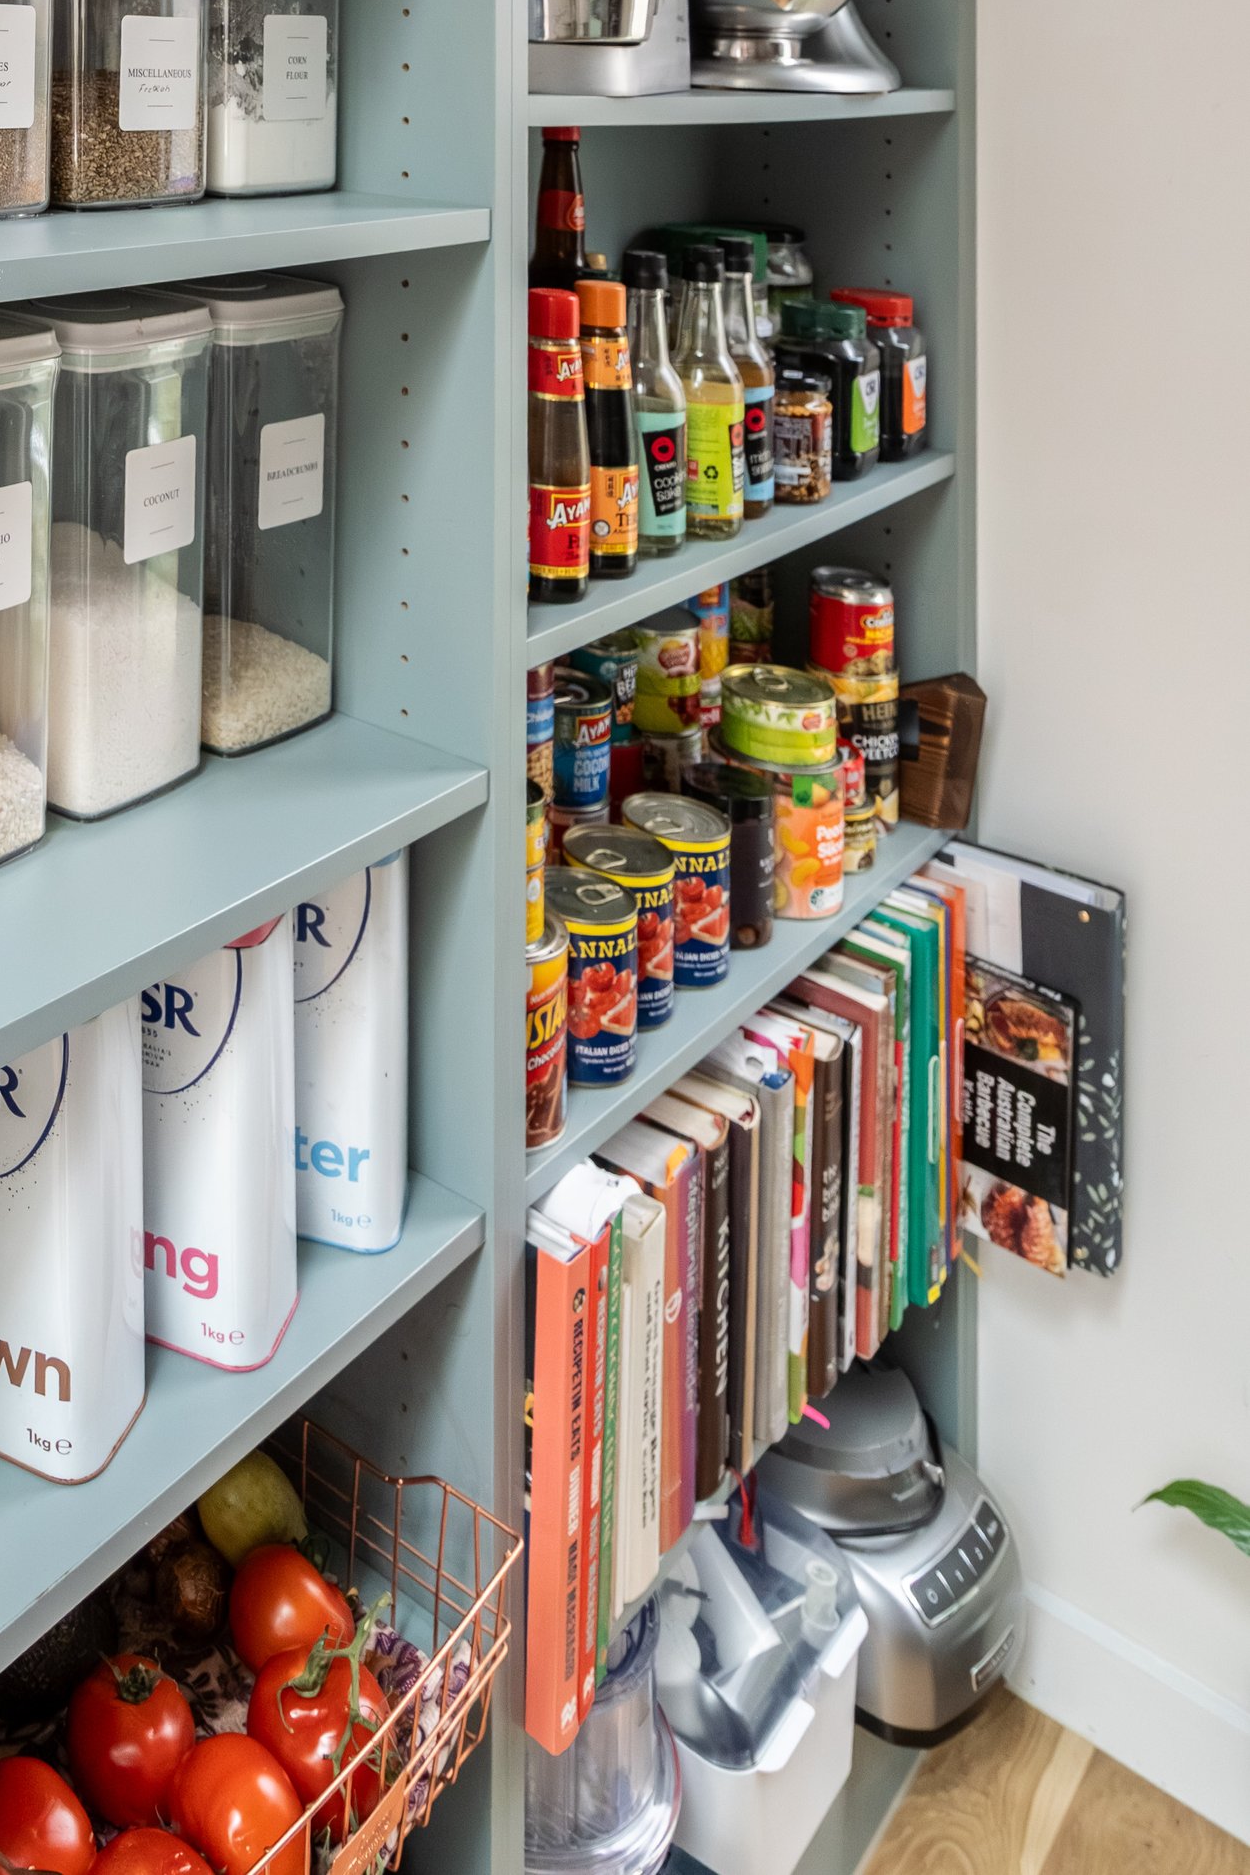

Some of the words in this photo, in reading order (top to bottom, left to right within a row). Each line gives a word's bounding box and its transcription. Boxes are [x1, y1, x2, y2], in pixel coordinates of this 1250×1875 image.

[287, 56, 308, 65] CORN
[127, 68, 192, 79] MISCELLANEOUS
[286, 71, 308, 80] FLOUR
[266, 460, 319, 483] BREADCRUMBS
[143, 487, 181, 509] COCONUT
[975, 1068, 996, 1150] Barbecue
[996, 1075, 1016, 1162] Australian
[1015, 1088, 1037, 1168] Complete
[1037, 1123, 1056, 1156] The
[330, 1208, 354, 1228] 1kg
[714, 1214, 730, 1398] KITCHEN
[200, 1322, 225, 1344] 1kg
[570, 1317, 583, 1412] RECIPETIN
[26, 1428, 52, 1453] 1kg
[570, 1413, 582, 1462] EATS
